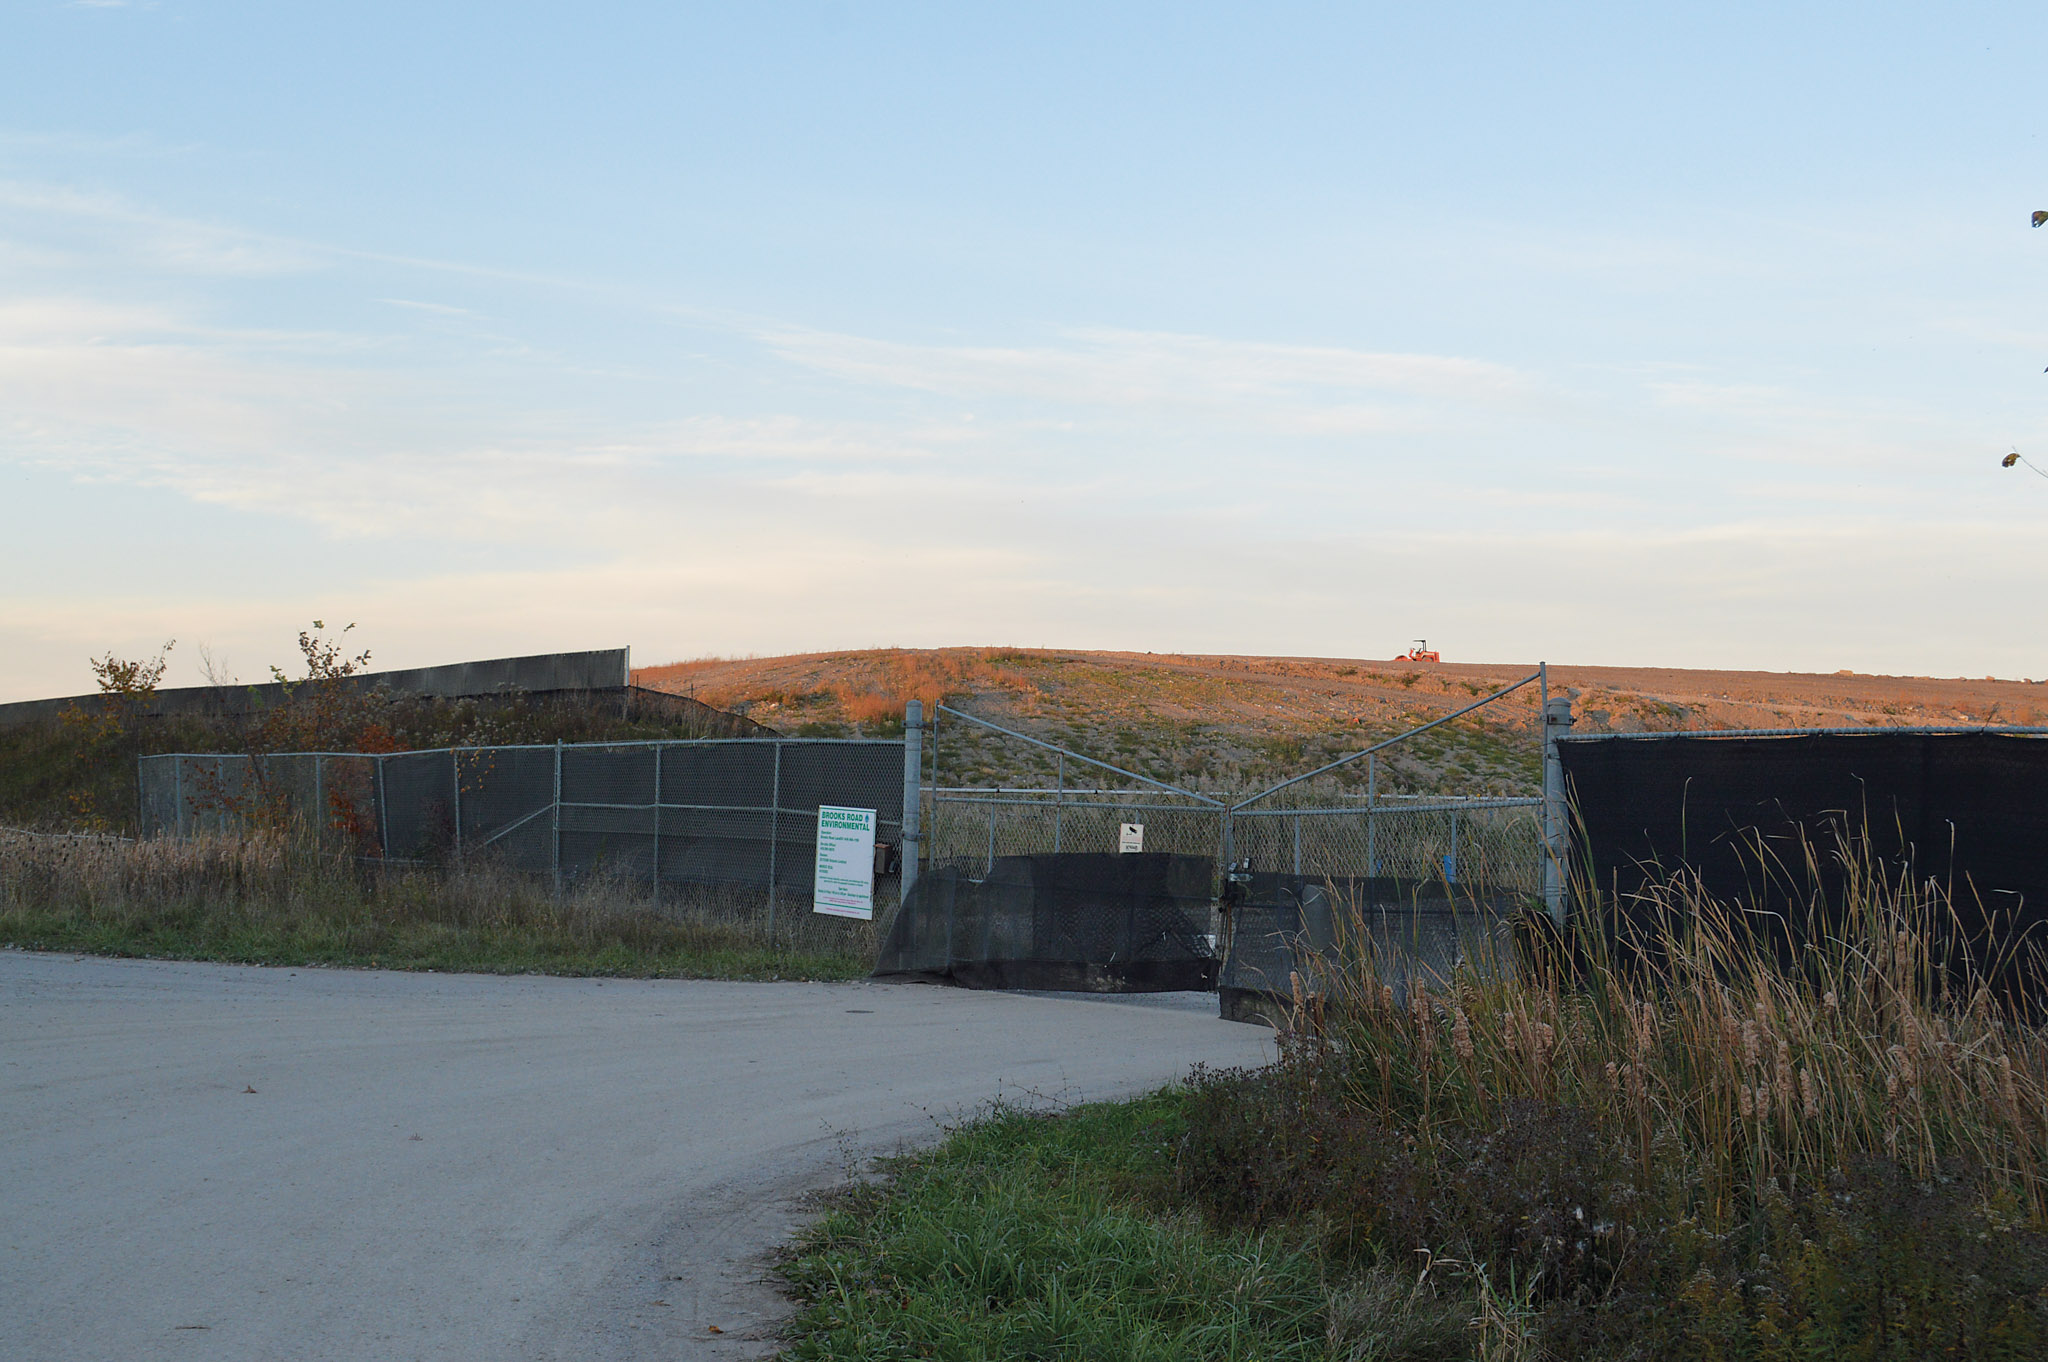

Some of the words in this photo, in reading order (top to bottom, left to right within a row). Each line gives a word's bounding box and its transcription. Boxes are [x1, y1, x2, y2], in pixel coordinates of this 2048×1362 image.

[821, 811, 846, 821] BROOKS
[846, 813, 863, 822] ROAD
[821, 819, 870, 832] ENVIRONMENTAL
